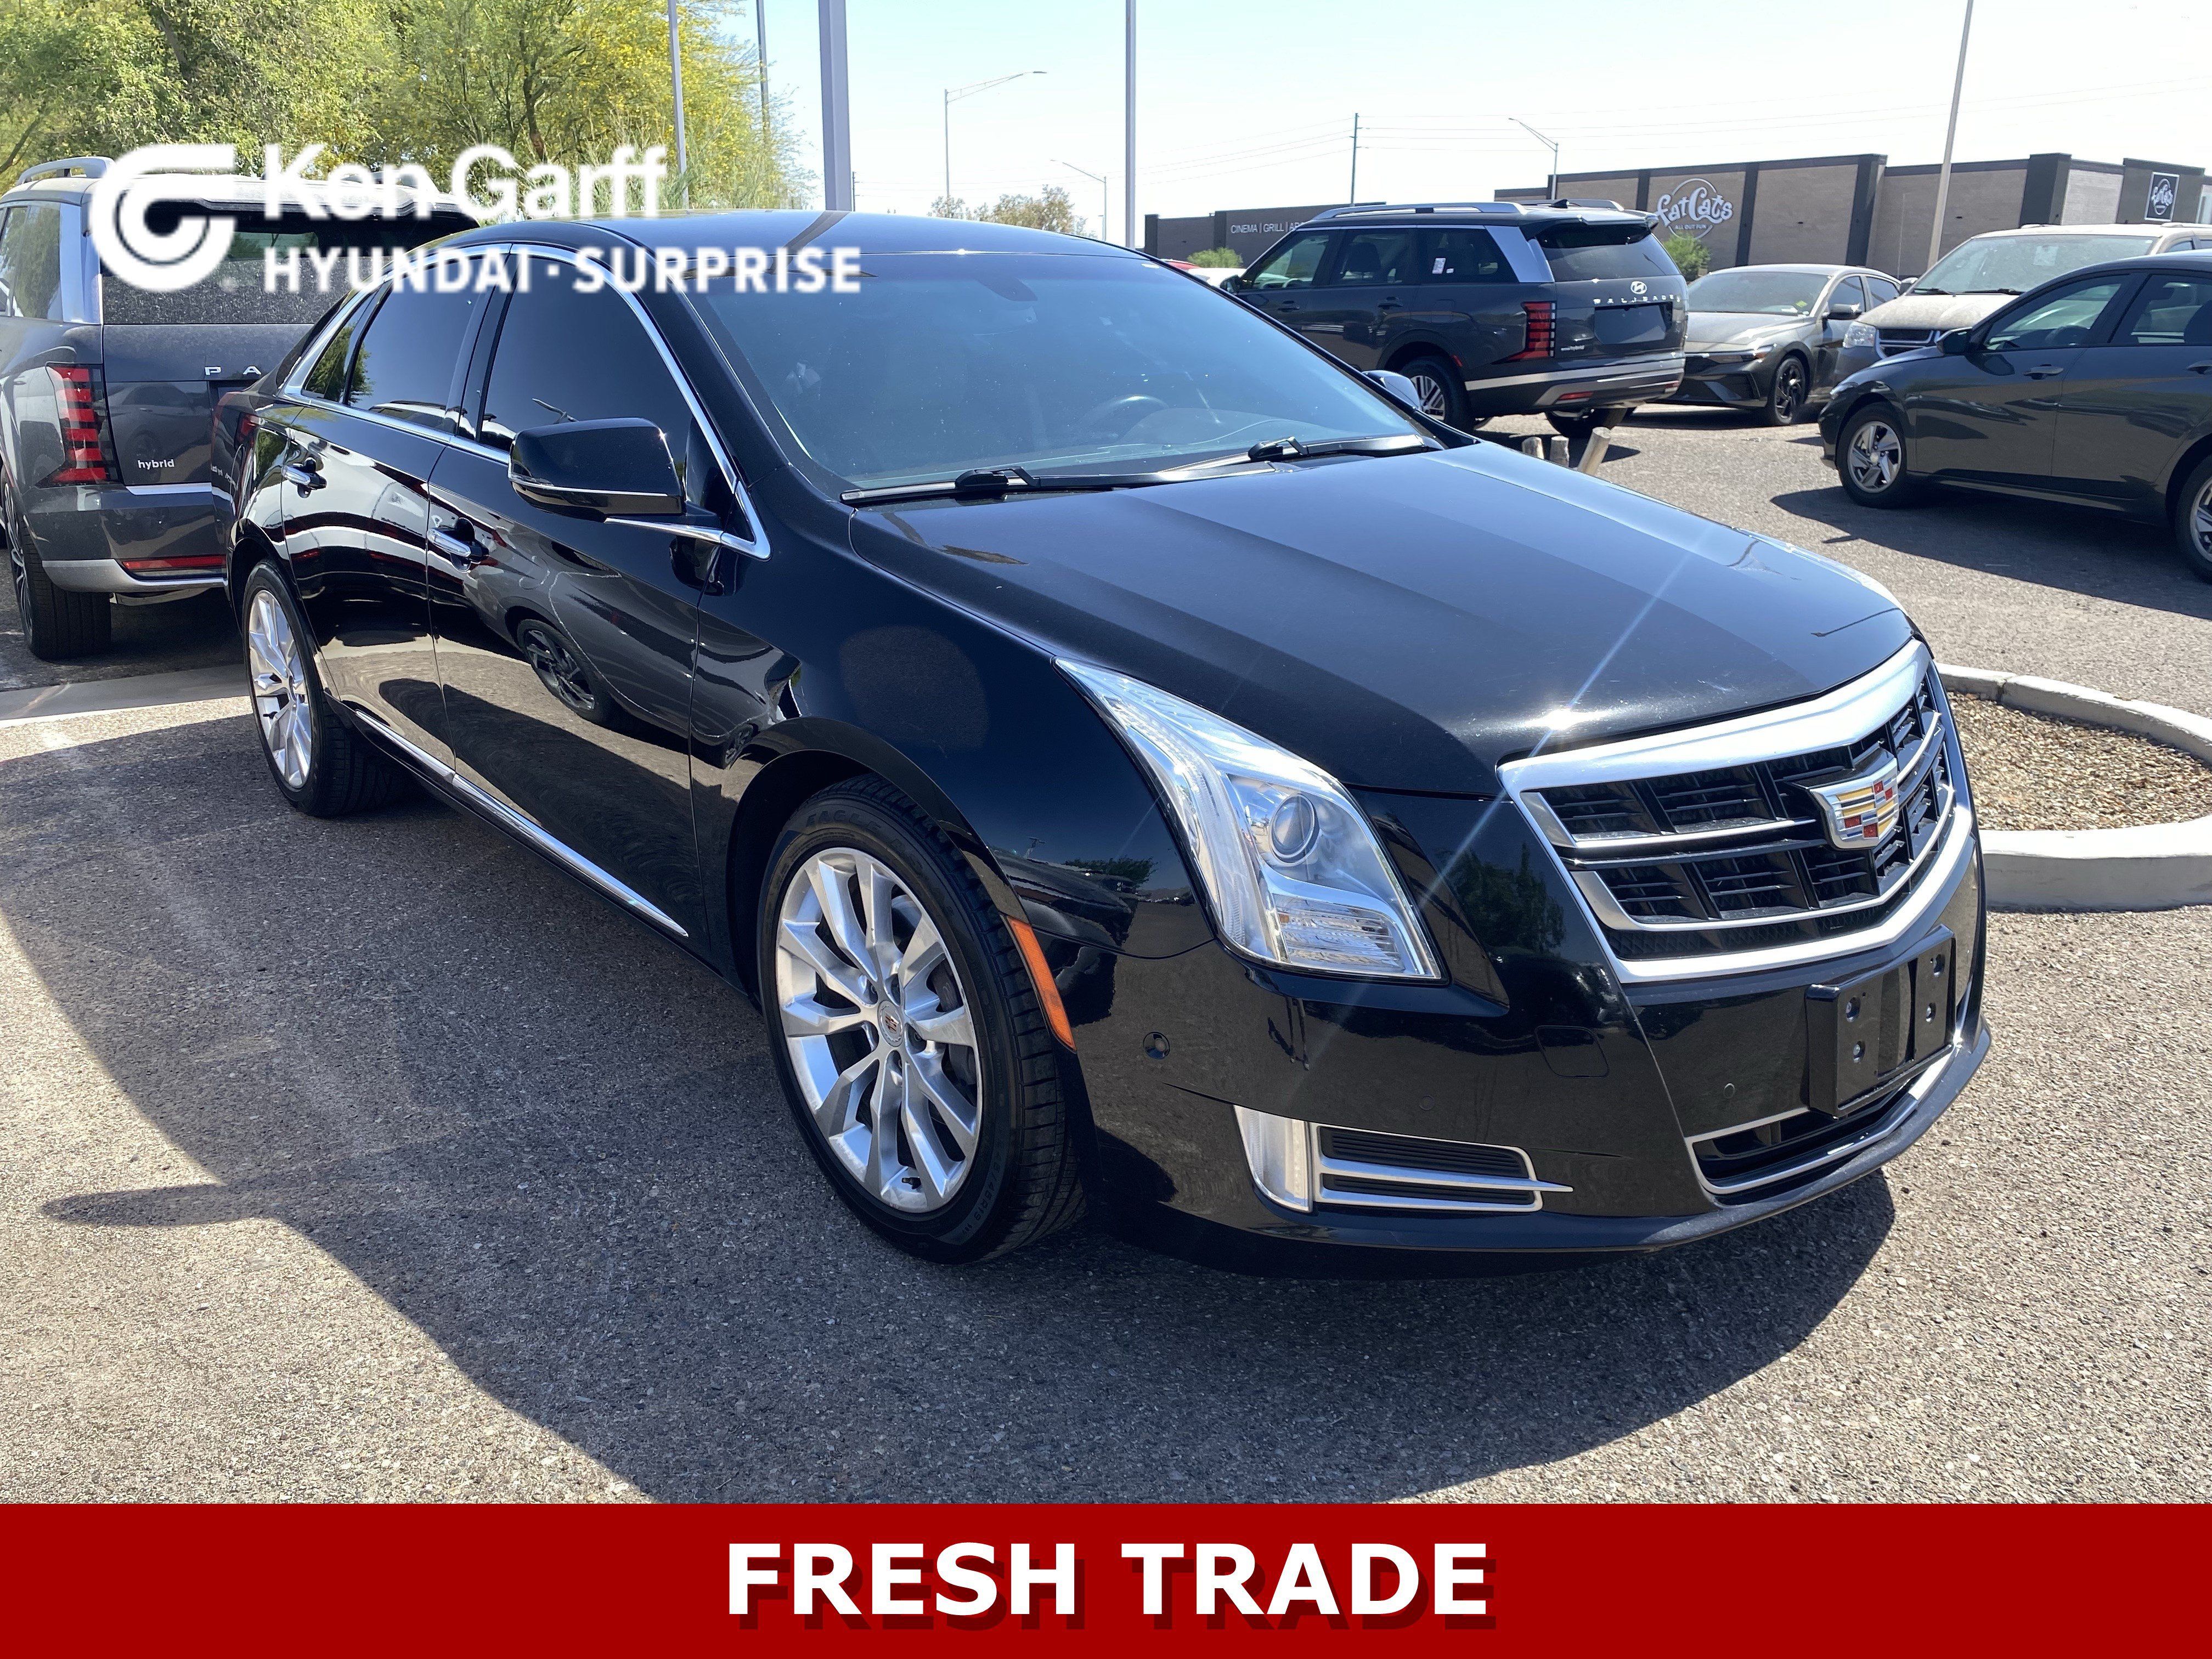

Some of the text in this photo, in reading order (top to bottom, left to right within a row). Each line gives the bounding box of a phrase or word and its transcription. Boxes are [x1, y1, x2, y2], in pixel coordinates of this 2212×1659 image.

[1231, 224, 1259, 234] CINEMA
[1262, 223, 1284, 233] GRILL
[138, 459, 175, 470] hybrid
